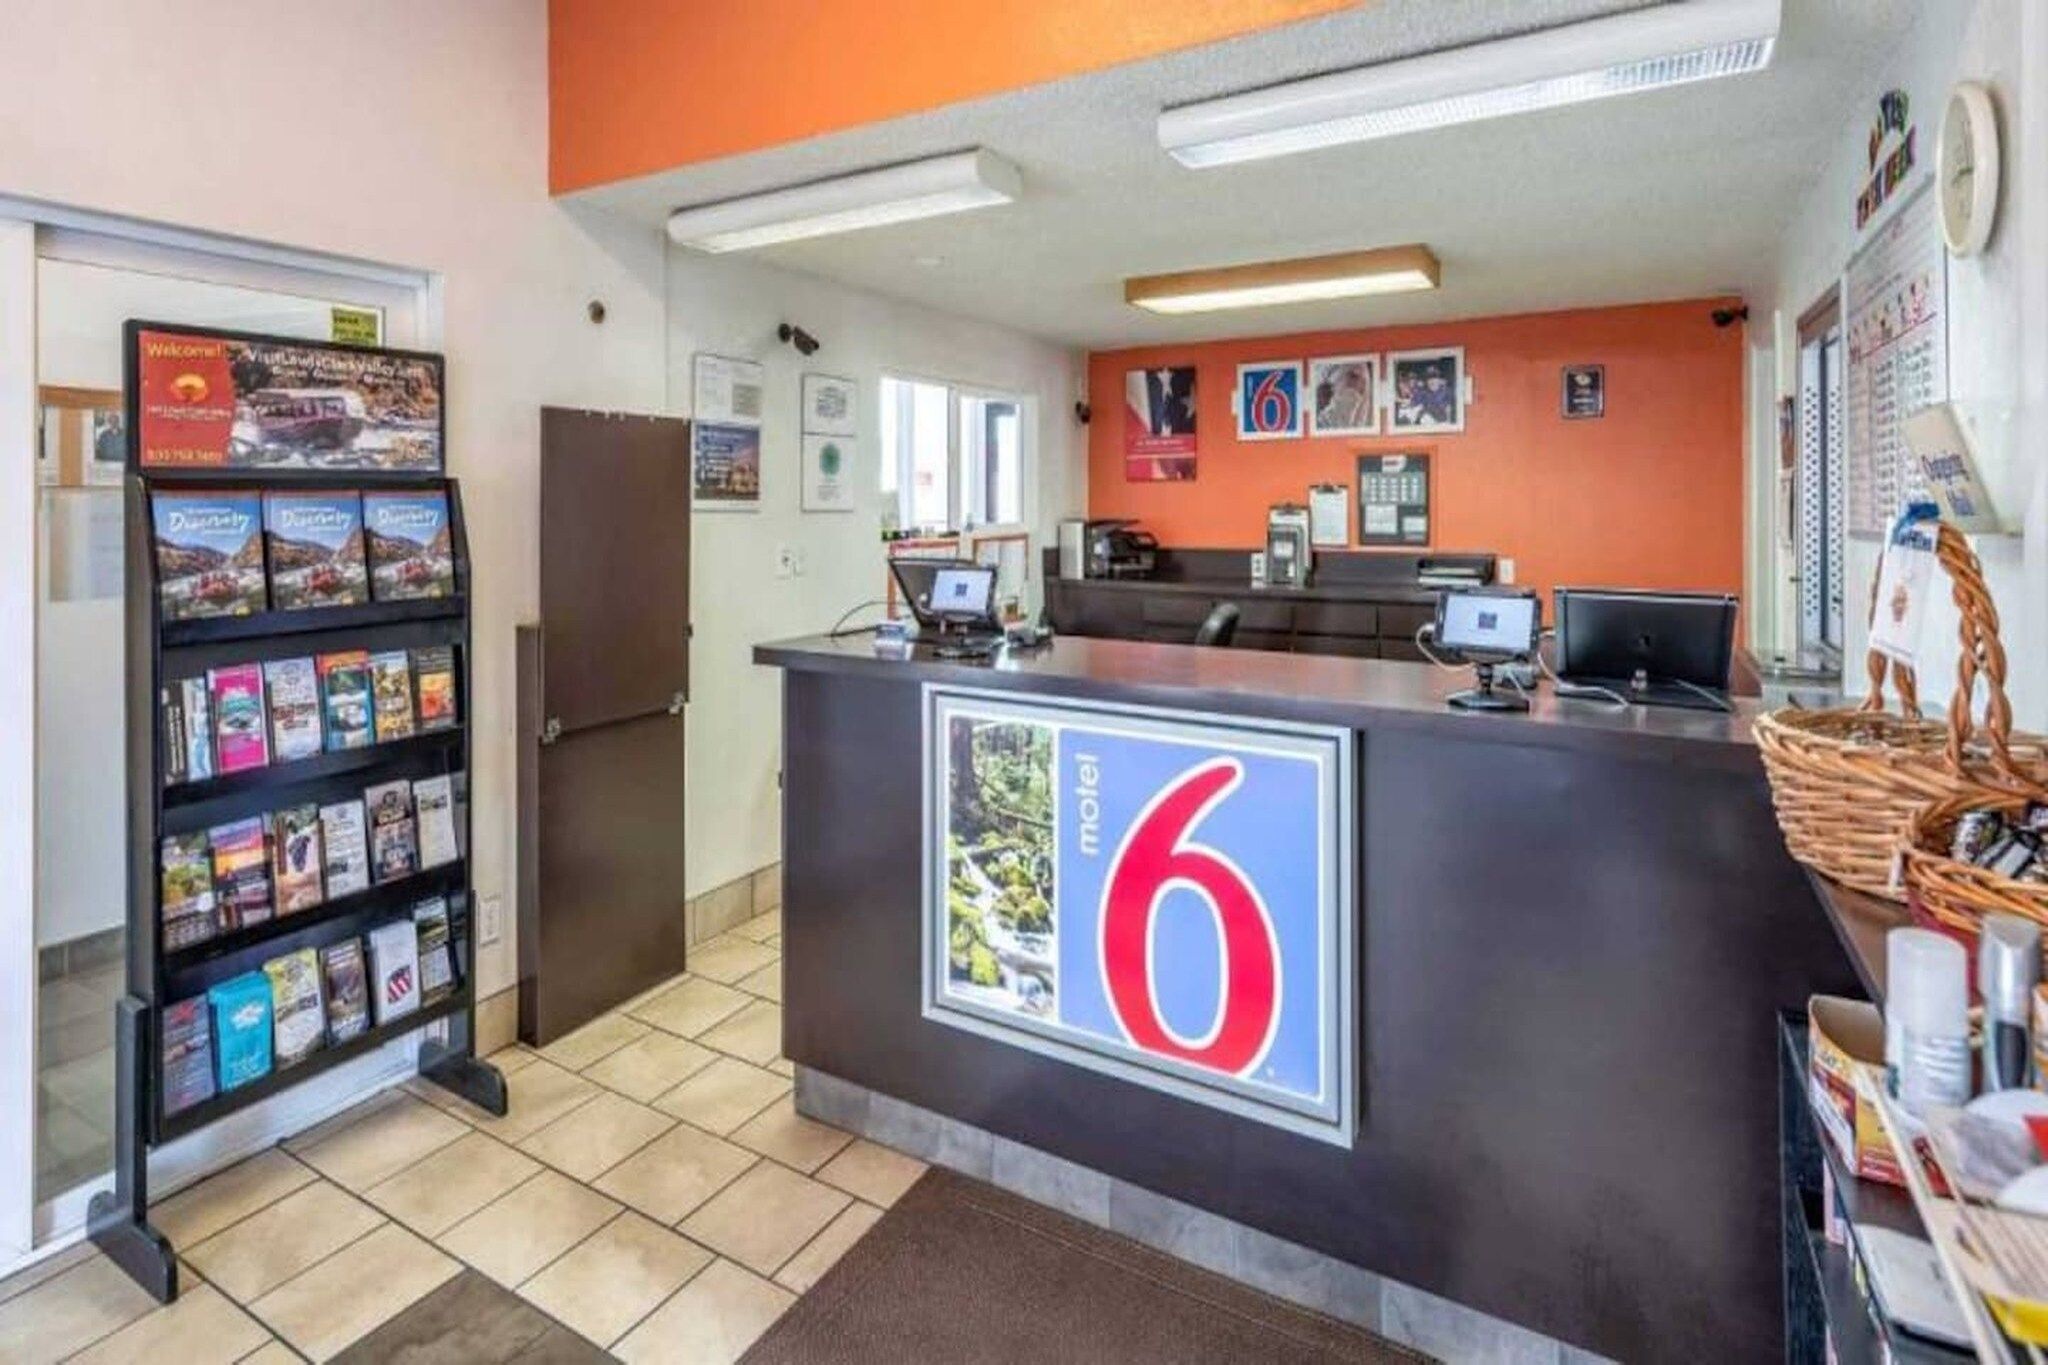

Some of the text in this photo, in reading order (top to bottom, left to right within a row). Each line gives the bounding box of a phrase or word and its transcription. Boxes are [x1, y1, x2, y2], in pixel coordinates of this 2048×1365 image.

[147, 342, 222, 359] Welcome!
[1252, 369, 1292, 433] 6
[1074, 752, 1099, 855] motel
[1098, 756, 1282, 1079] 6
